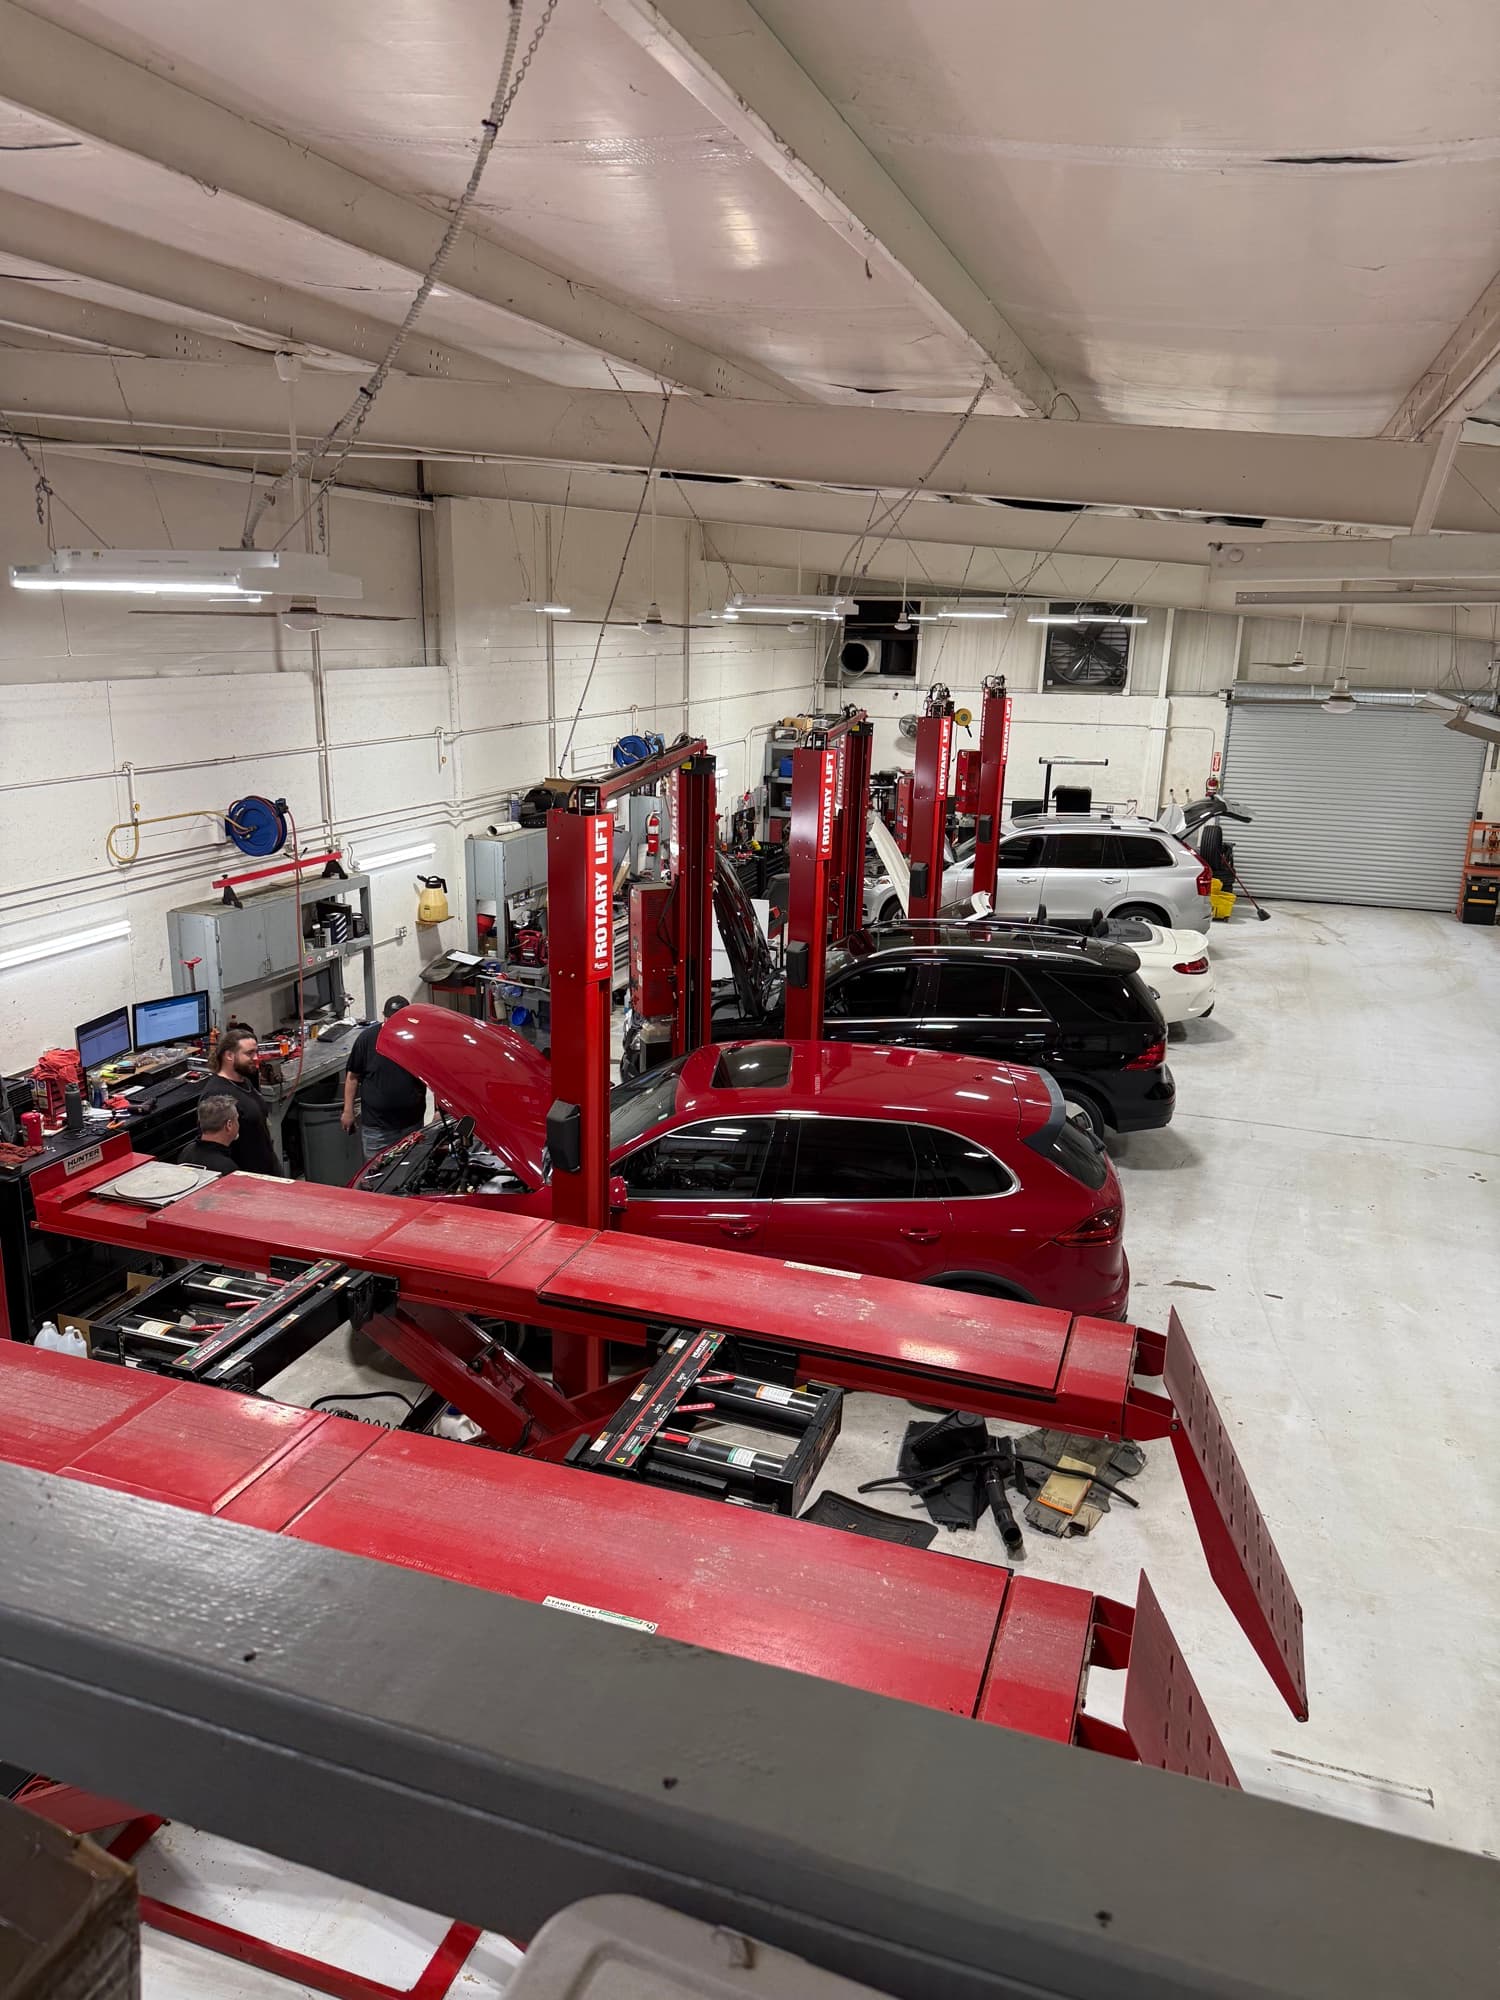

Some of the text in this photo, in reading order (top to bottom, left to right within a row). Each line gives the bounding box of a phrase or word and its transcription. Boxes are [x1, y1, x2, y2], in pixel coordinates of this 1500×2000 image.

[939, 746, 948, 790] ROTARY
[821, 753, 834, 845] ROTARY LIFT
[594, 818, 608, 959] ROTARY LIFT
[67, 1148, 100, 1168] HUNTER
[546, 1598, 571, 1608] STAND
